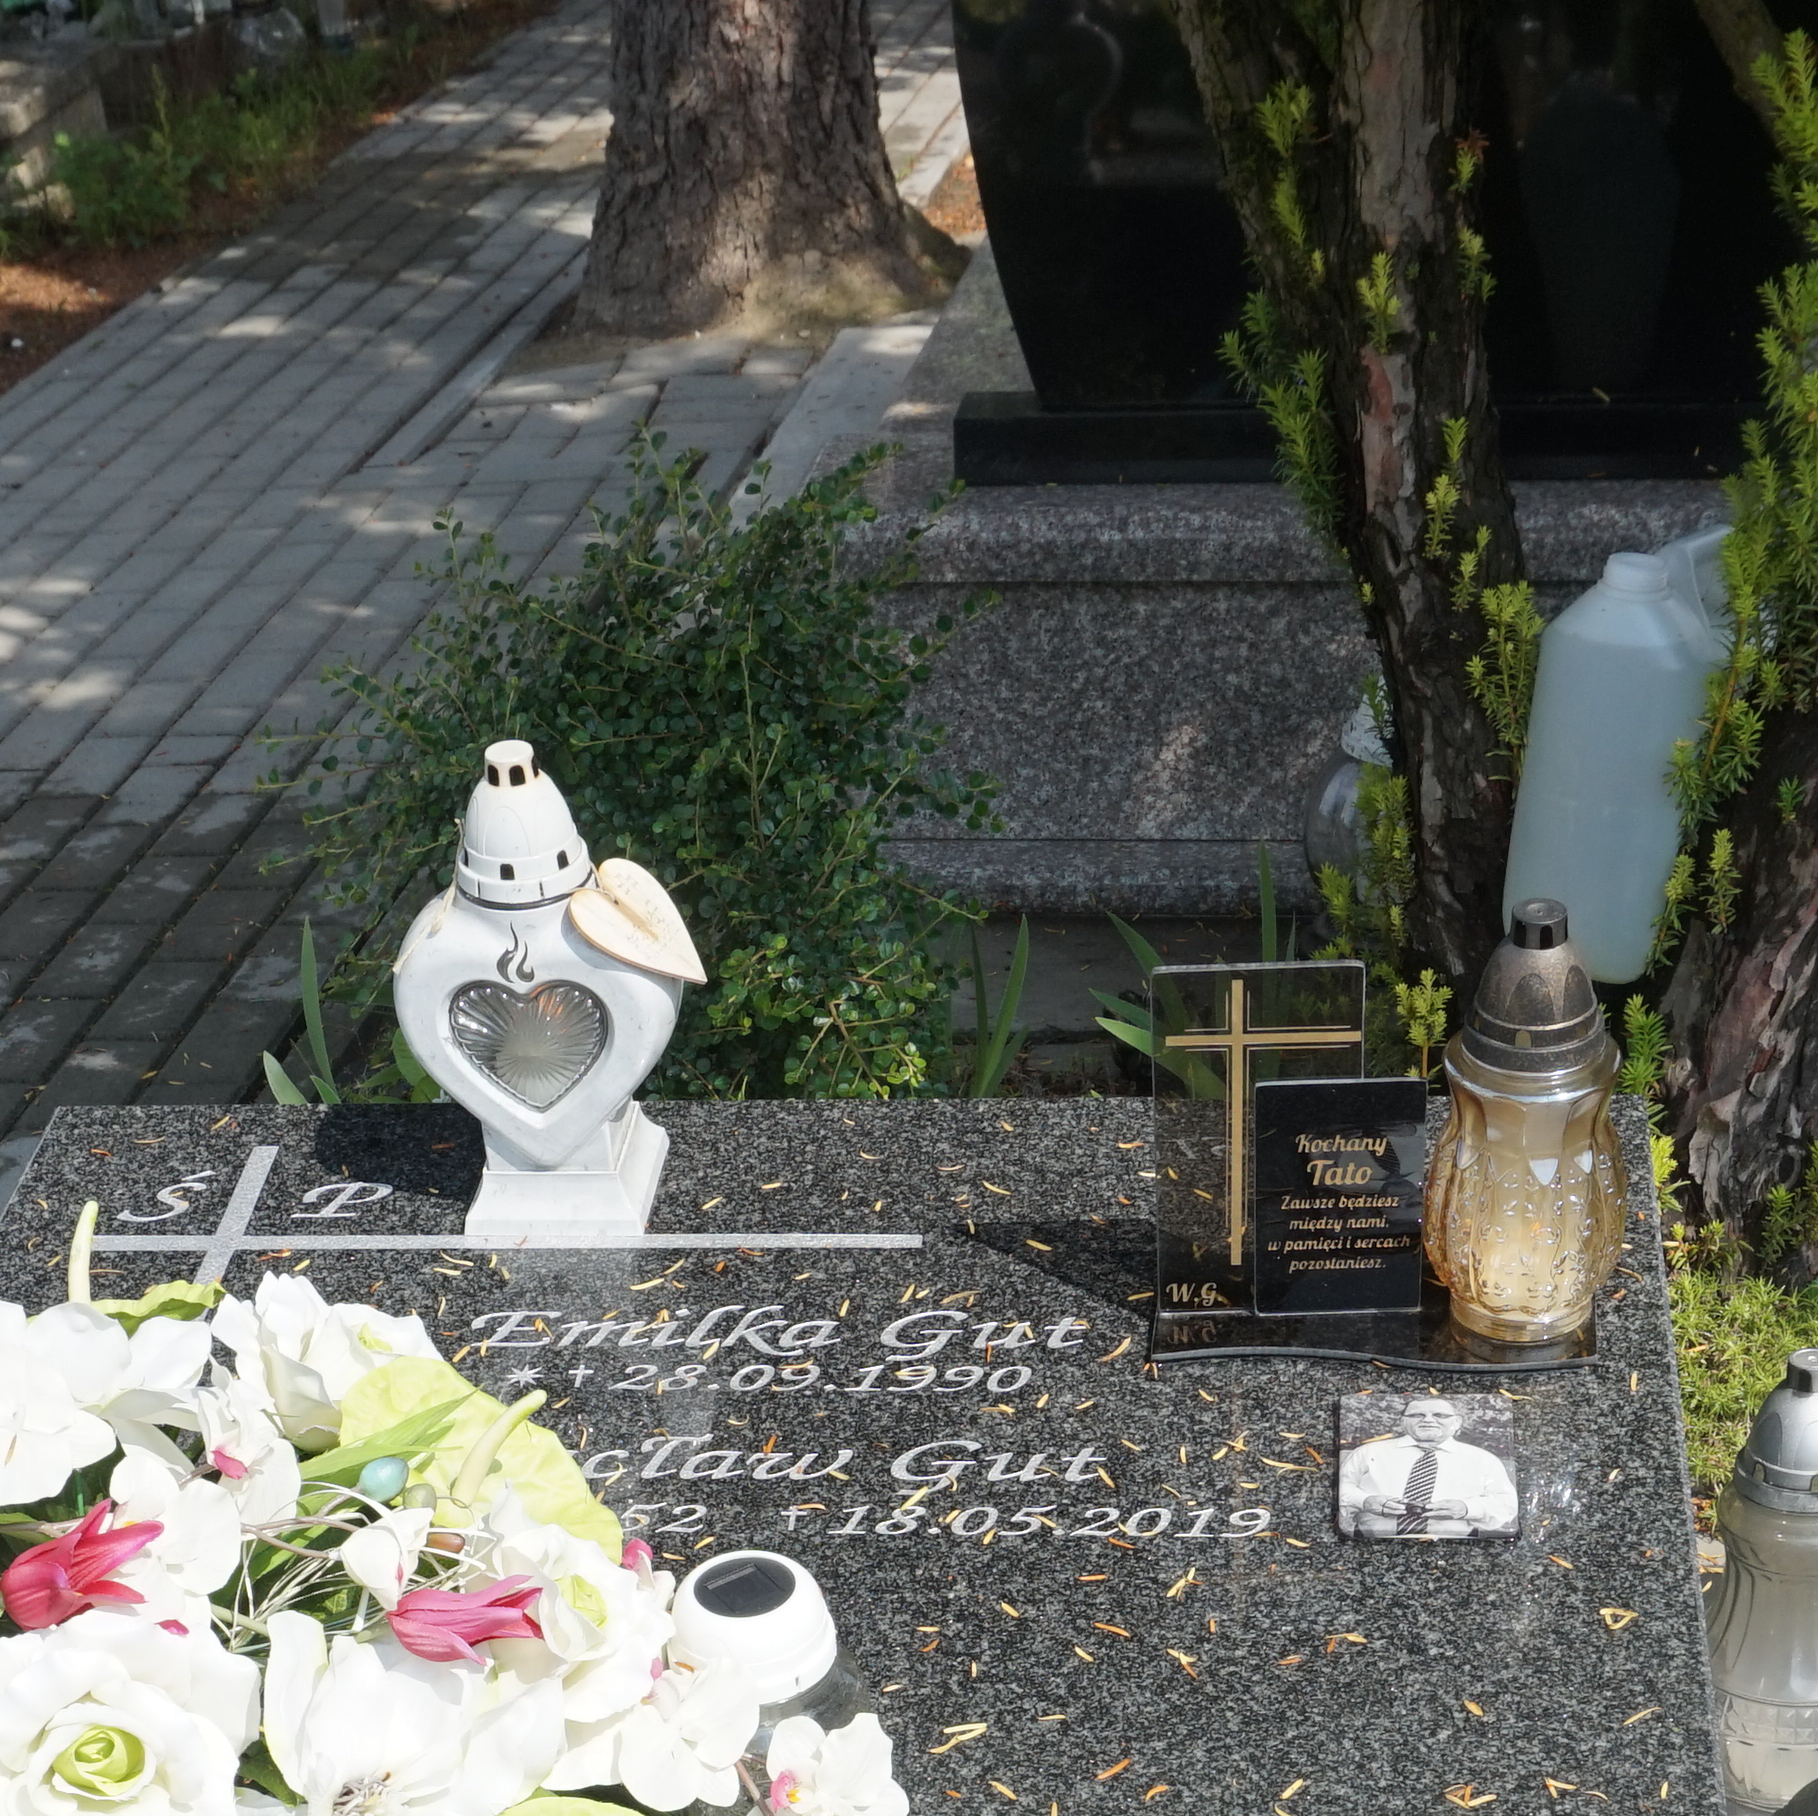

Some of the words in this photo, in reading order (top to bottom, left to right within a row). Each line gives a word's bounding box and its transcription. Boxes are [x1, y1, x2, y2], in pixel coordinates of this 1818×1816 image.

[1295, 1133, 1388, 1156] Kochany
[1307, 1159, 1373, 1186] Tato
[115, 1170, 216, 1222] Ś
[291, 1181, 393, 1218] P
[1281, 1195, 1334, 1209] Zawsze
[1338, 1194, 1400, 1210] będziesz
[1289, 1216, 1343, 1232] między
[1267, 1240, 1281, 1251] w
[1283, 1236, 1343, 1254] pamięci
[1346, 1235, 1351, 1248] i
[1354, 1234, 1411, 1248] sercach
[1289, 1256, 1387, 1274] pozostaniesz.
[470, 1304, 841, 1357] Emilka
[880, 1310, 1086, 1362] Gut
[607, 1363, 1033, 1393] 28.09.1990
[569, 1432, 854, 1481] cław
[889, 1439, 1107, 1495] Gut
[828, 1505, 1272, 1537] 18.05.2019
